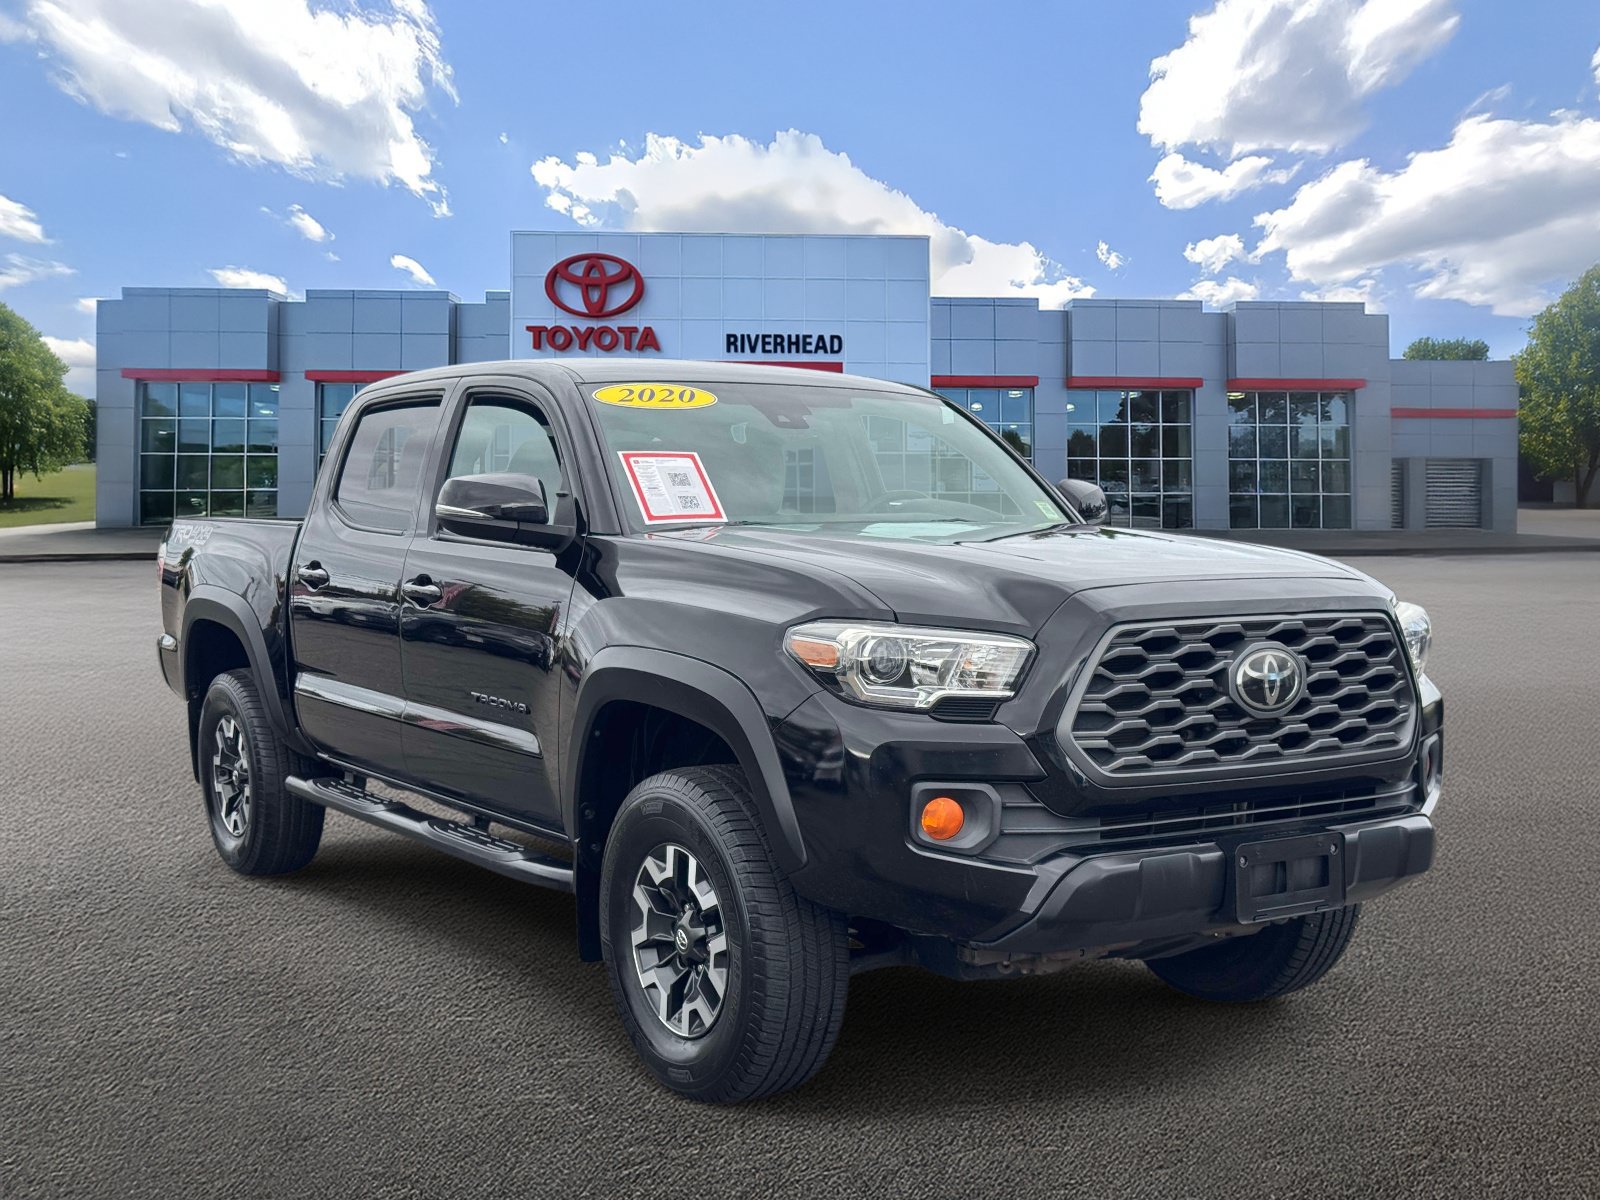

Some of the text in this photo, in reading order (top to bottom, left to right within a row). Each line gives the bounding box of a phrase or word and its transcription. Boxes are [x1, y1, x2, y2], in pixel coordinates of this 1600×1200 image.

[526, 325, 660, 352] TOYOTA
[726, 333, 843, 355] RIVERHEAD
[618, 388, 696, 403] 2020
[470, 691, 531, 715] TACOMA
